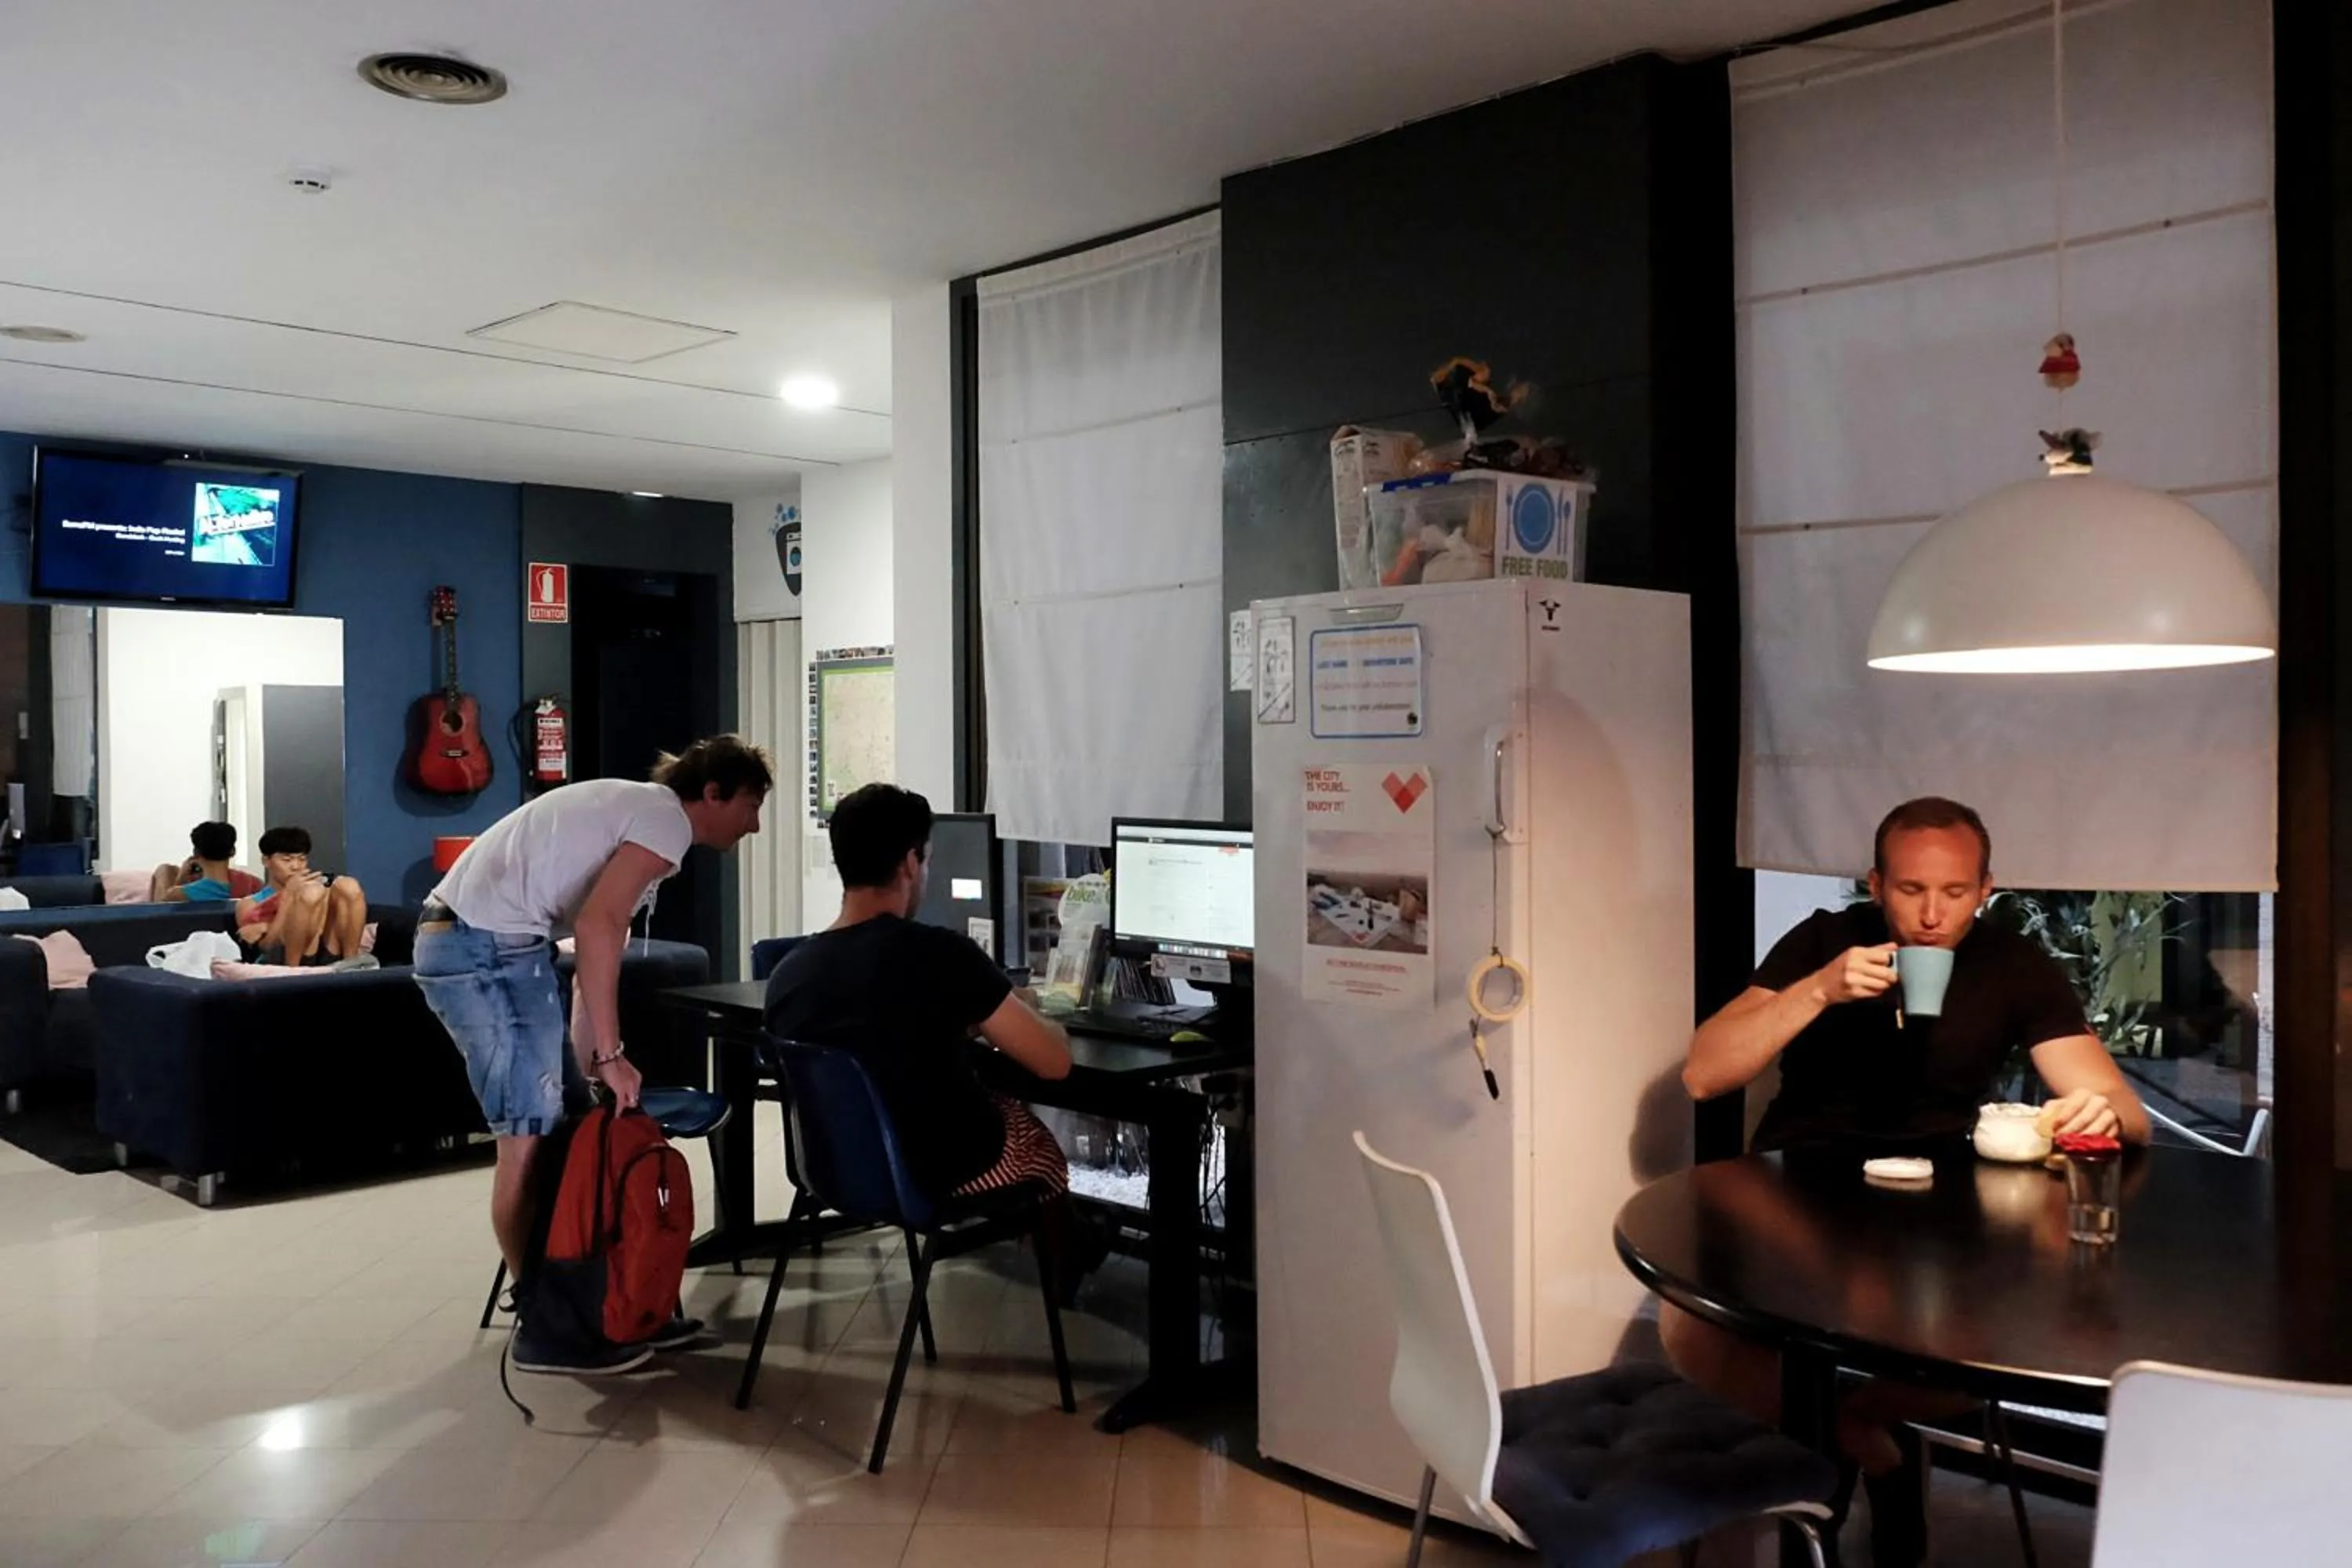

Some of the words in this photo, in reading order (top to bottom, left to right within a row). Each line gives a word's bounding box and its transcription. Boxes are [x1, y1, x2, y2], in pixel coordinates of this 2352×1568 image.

[1502, 556, 1532, 575] FREE
[1537, 557, 1568, 579] FOOD
[531, 607, 566, 619] EXTINTOR
[1305, 771, 1321, 781] THE
[1323, 771, 1341, 781] CITY
[1307, 782, 1315, 792] IS
[1307, 800, 1332, 811] ENJOY
